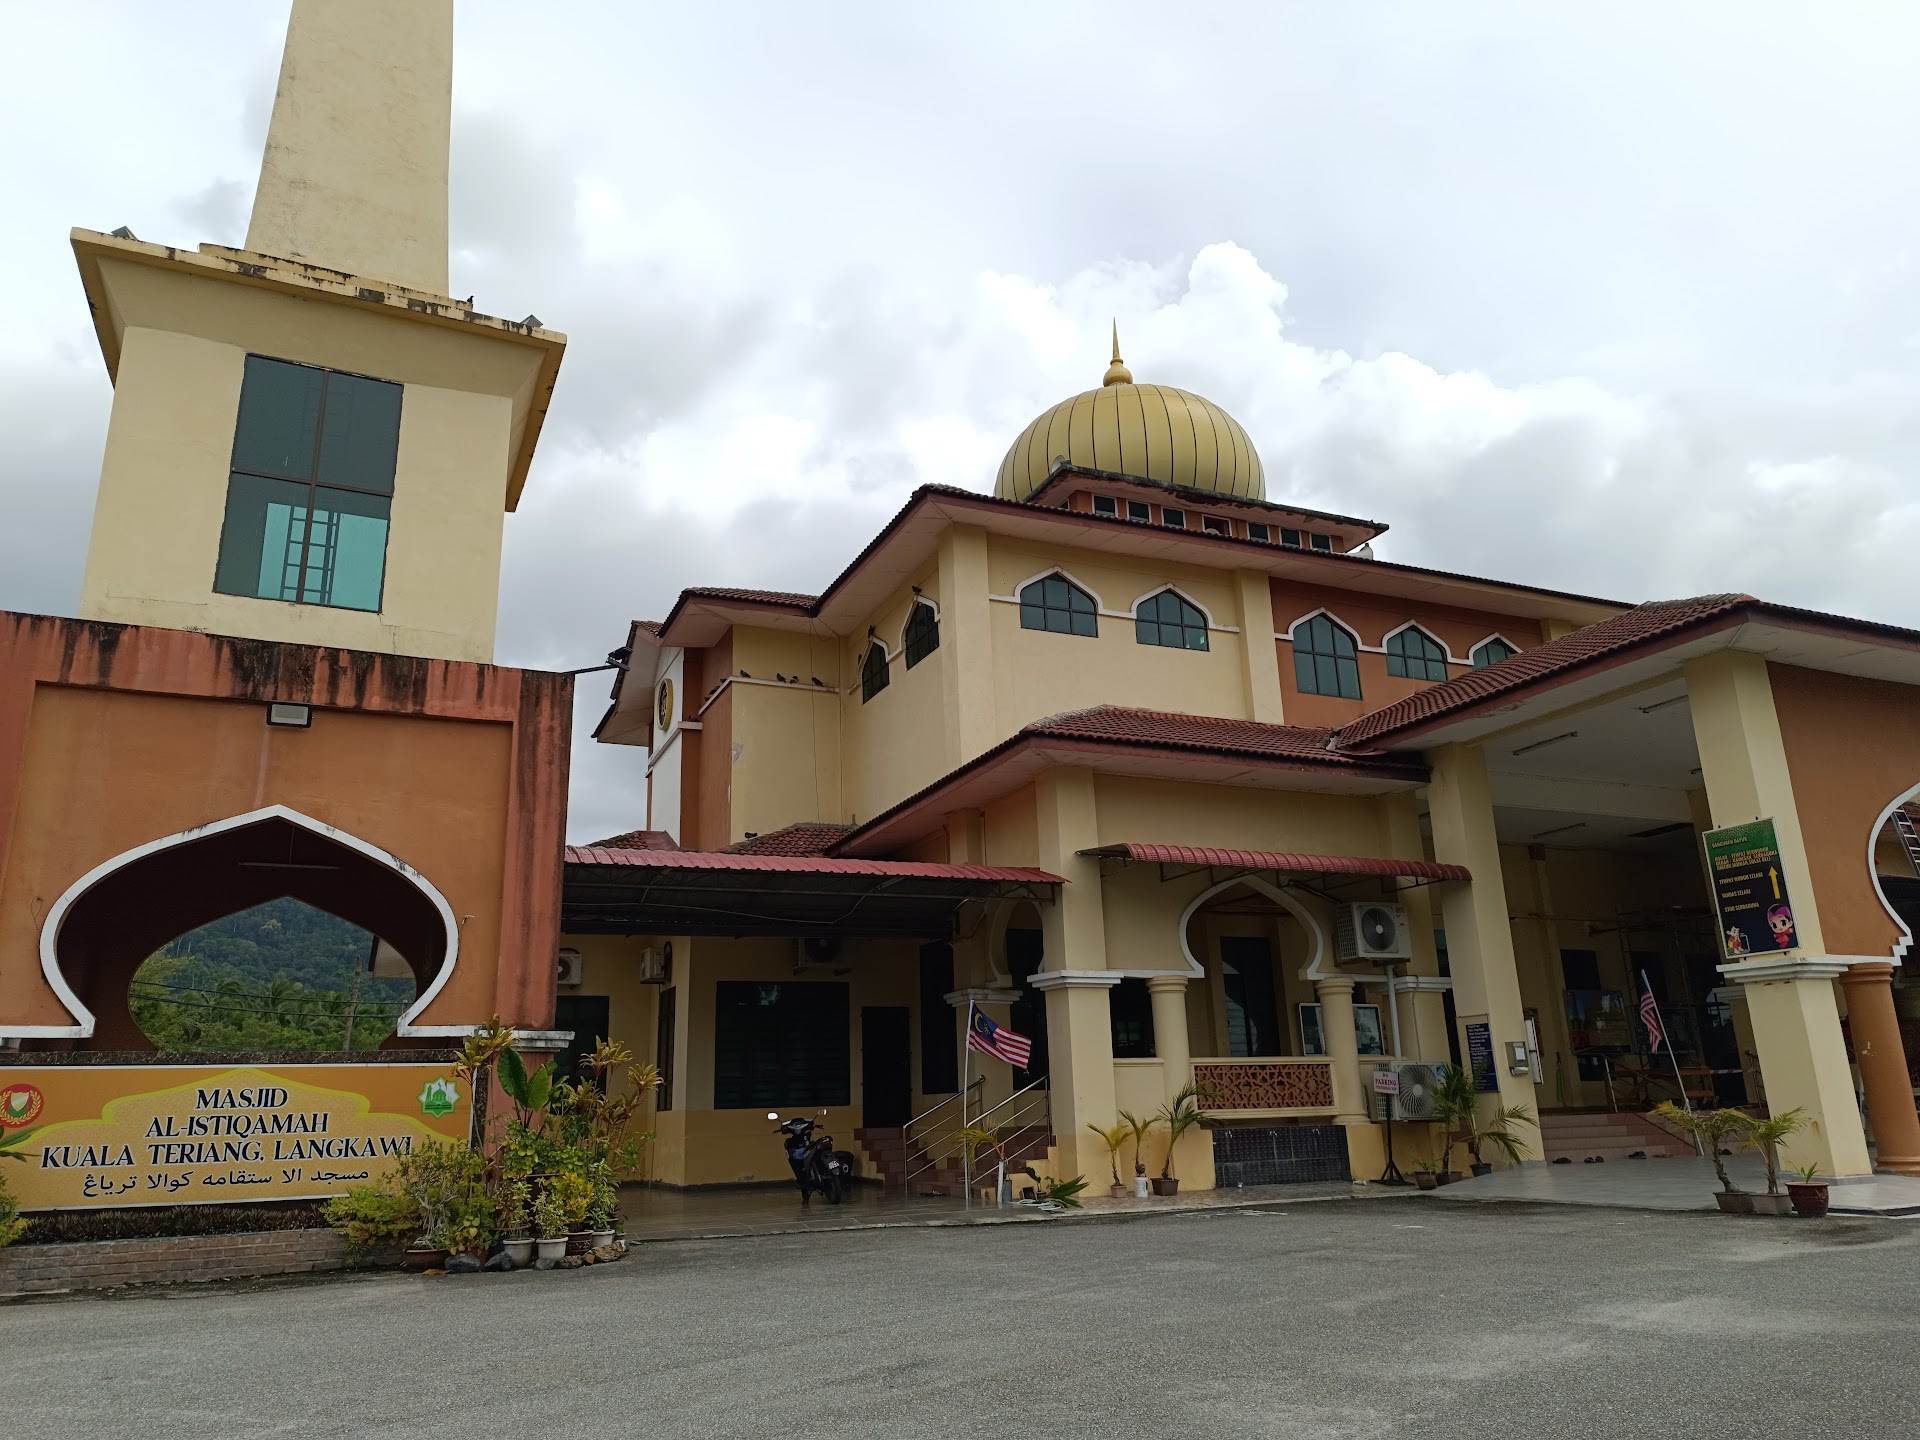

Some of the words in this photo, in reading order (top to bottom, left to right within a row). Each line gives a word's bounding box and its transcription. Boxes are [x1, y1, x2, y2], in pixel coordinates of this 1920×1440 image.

[195, 1087, 288, 1109] MASJID
[145, 1112, 329, 1138] AL-ISTIQAMAH
[41, 1145, 135, 1168] KUALA
[273, 1136, 412, 1160] LANGKAWI
[310, 1170, 369, 1185] مسجد
